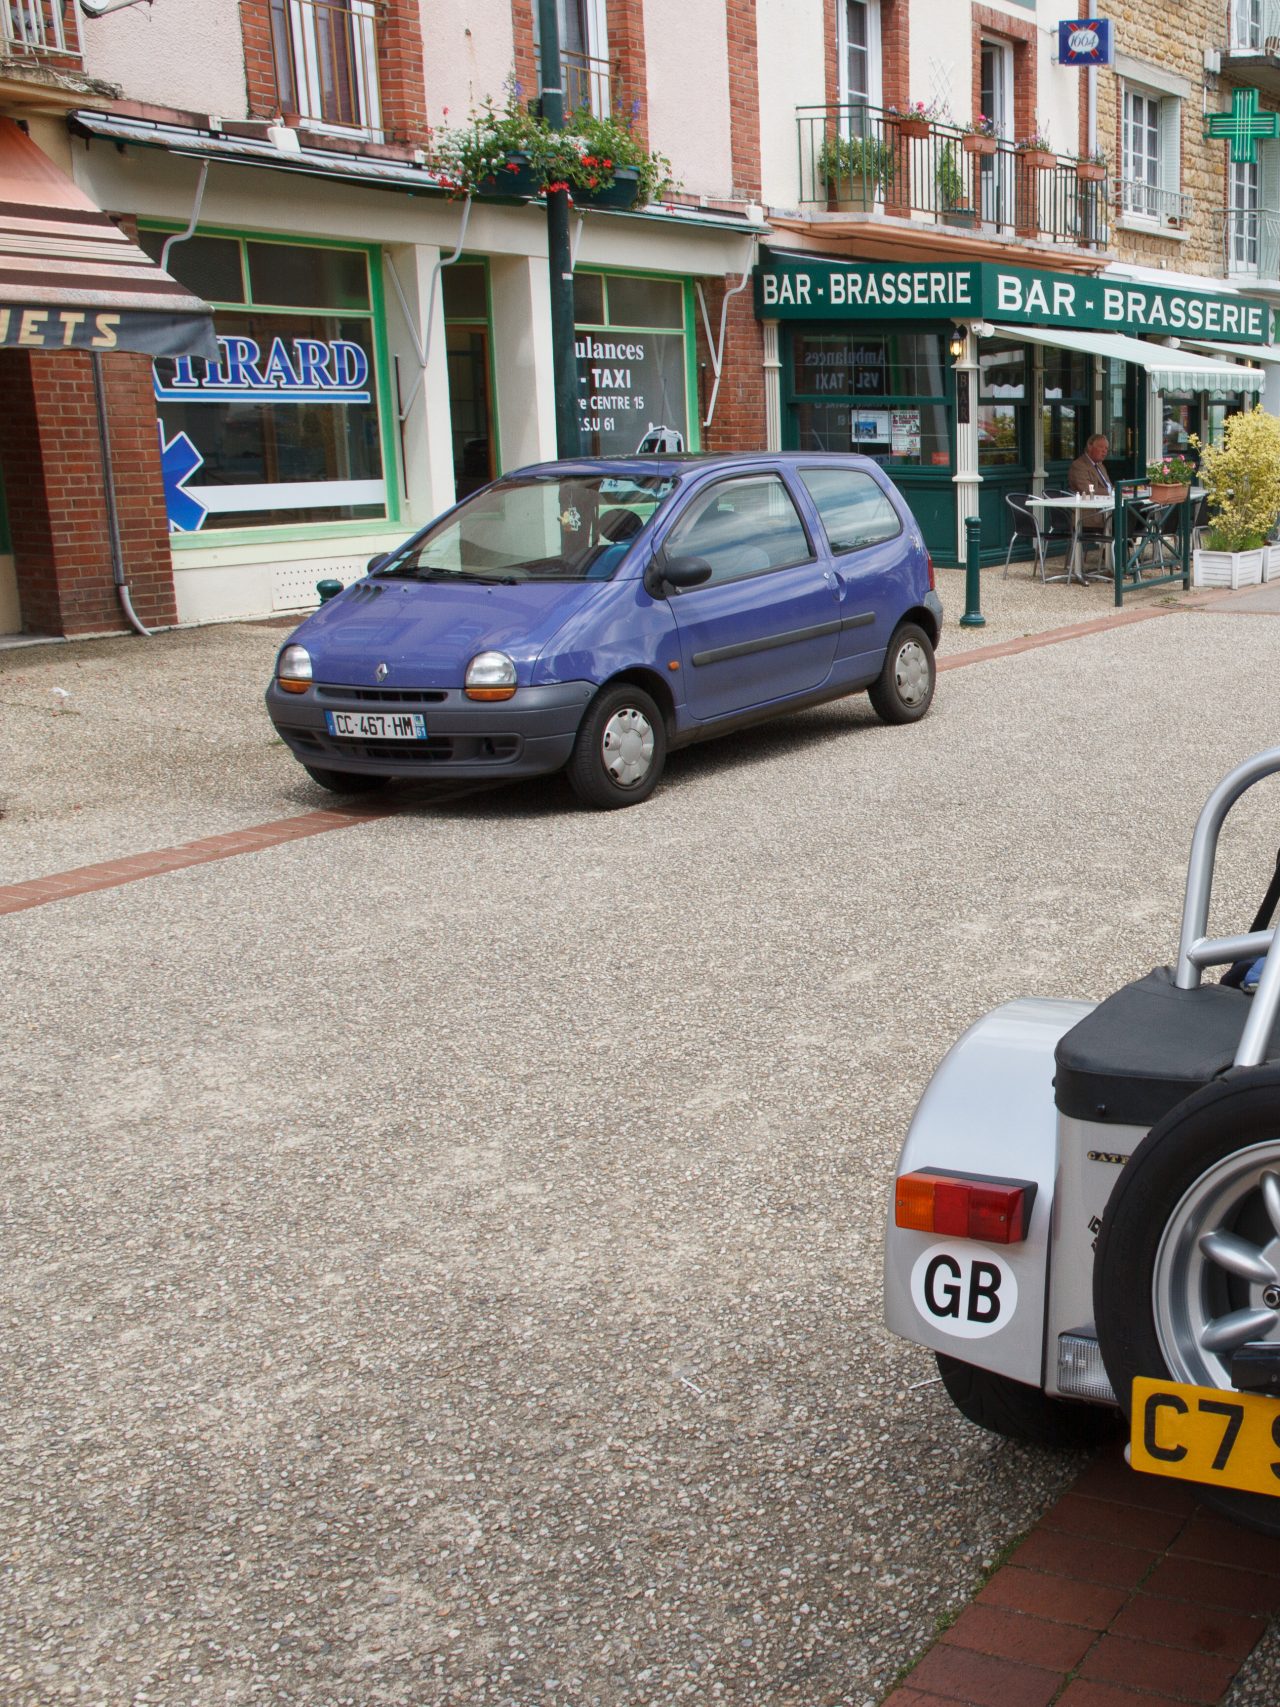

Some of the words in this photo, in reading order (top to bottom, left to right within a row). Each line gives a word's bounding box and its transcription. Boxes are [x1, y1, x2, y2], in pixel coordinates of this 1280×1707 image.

[1070, 34, 1097, 48] 1664
[763, 273, 812, 305] BAR
[829, 271, 972, 304] BRASSERIE
[997, 274, 1077, 317] BAR
[1103, 288, 1263, 336] BRASSERIE
[592, 368, 632, 388] TAXI
[590, 395, 630, 410] CENTRE
[634, 396, 644, 410] 15
[604, 417, 615, 431] 61
[416, 726, 426, 737] 61
[924, 1254, 1002, 1324] GB
[1143, 1392, 1244, 1472] C7
